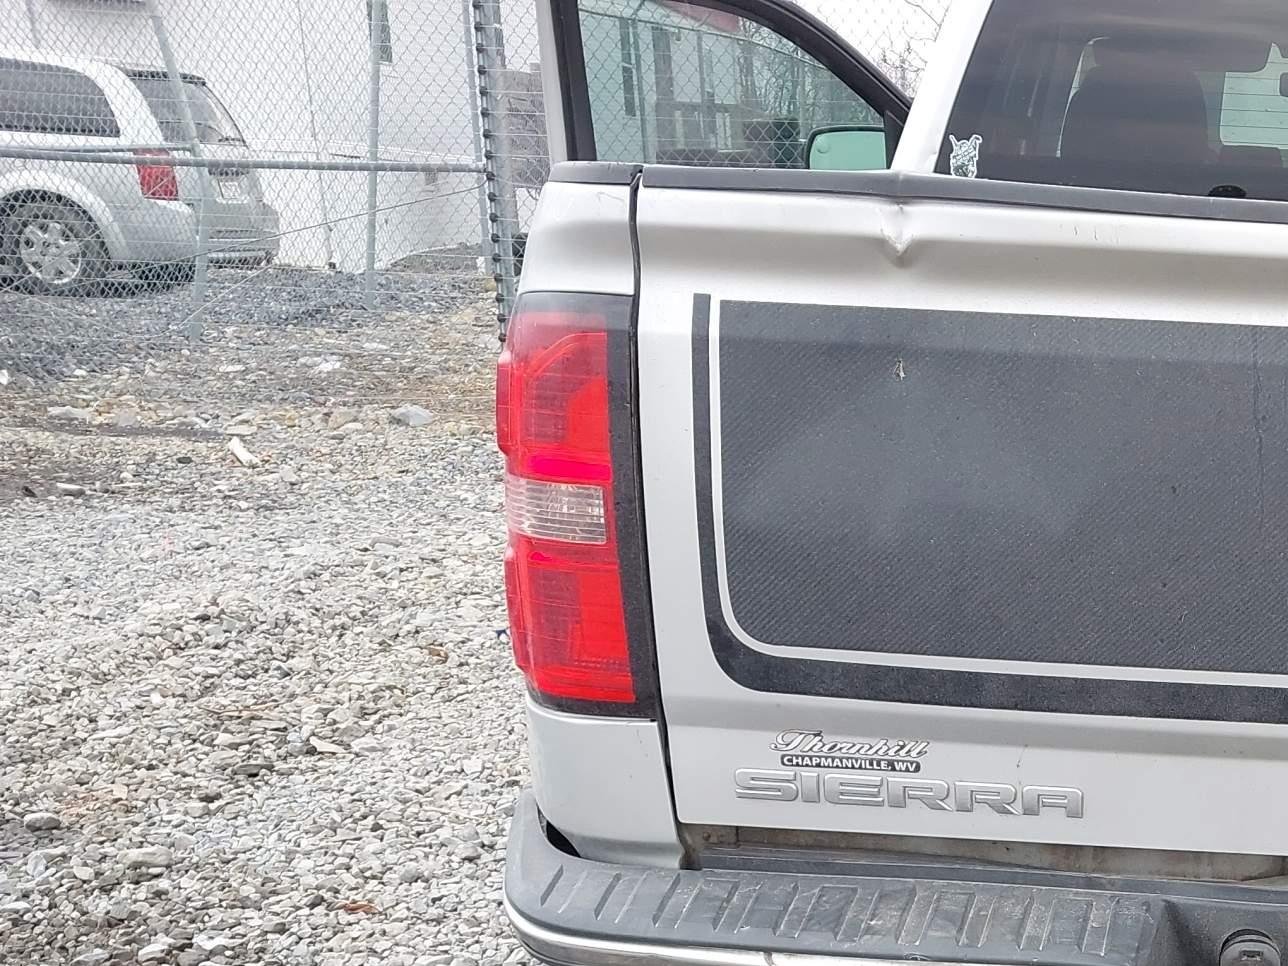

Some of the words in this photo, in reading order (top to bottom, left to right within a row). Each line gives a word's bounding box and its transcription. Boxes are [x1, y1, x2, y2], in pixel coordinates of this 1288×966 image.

[769, 729, 930, 759] Thornhill
[783, 755, 892, 771] CHAPMANVILLE,
[894, 761, 918, 772] WV
[734, 768, 1085, 818] SIERRA
